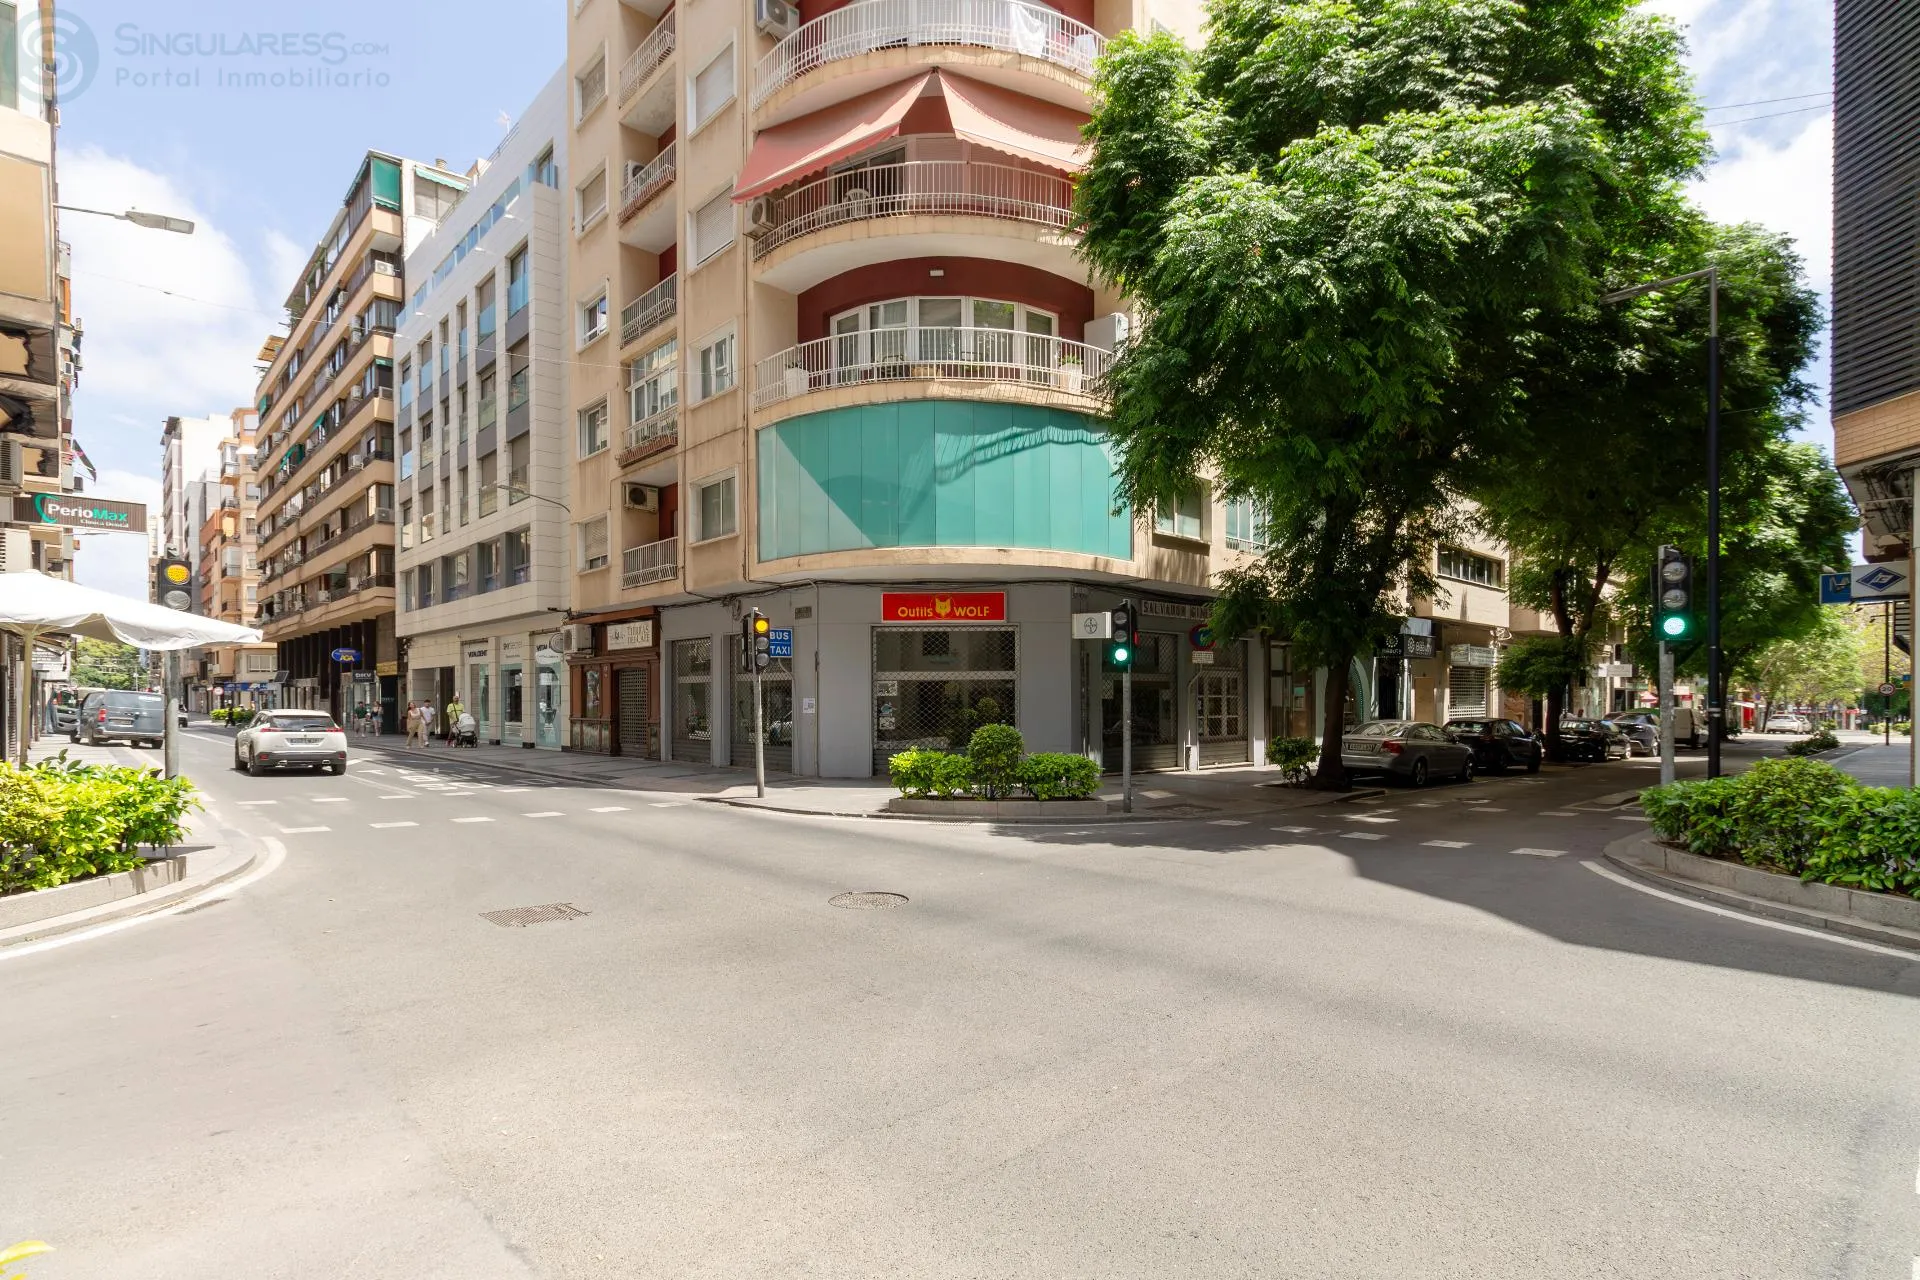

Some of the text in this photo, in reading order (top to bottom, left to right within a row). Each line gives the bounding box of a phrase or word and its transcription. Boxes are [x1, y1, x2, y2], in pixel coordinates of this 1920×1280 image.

[47, 503, 127, 521] PerioMax
[897, 606, 990, 617] Outils WOLF
[769, 631, 789, 640] BUS
[769, 646, 790, 655] TAXI
